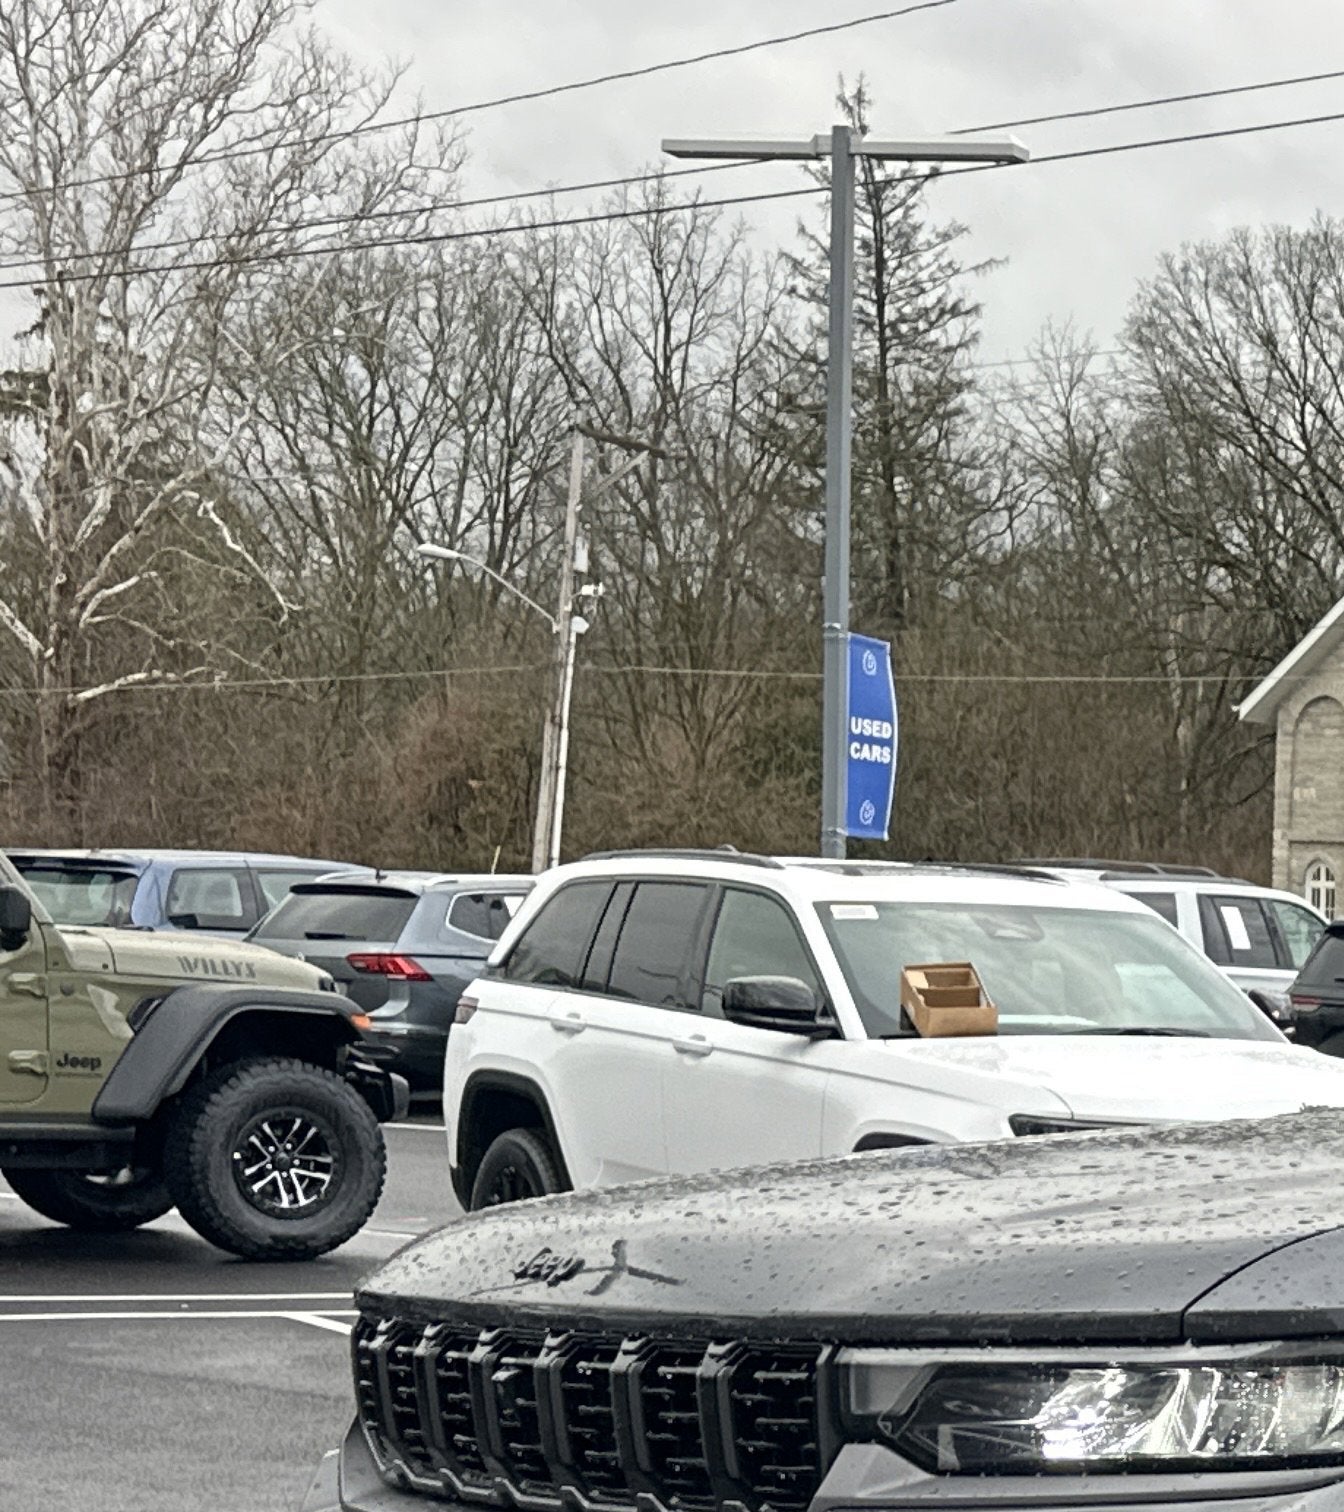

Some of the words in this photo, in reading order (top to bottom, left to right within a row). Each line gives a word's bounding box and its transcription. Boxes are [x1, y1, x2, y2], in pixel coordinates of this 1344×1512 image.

[850, 716, 893, 740] USED
[849, 742, 891, 764] CARS
[177, 956, 256, 979] WILLYS
[56, 1053, 102, 1071] Jeep
